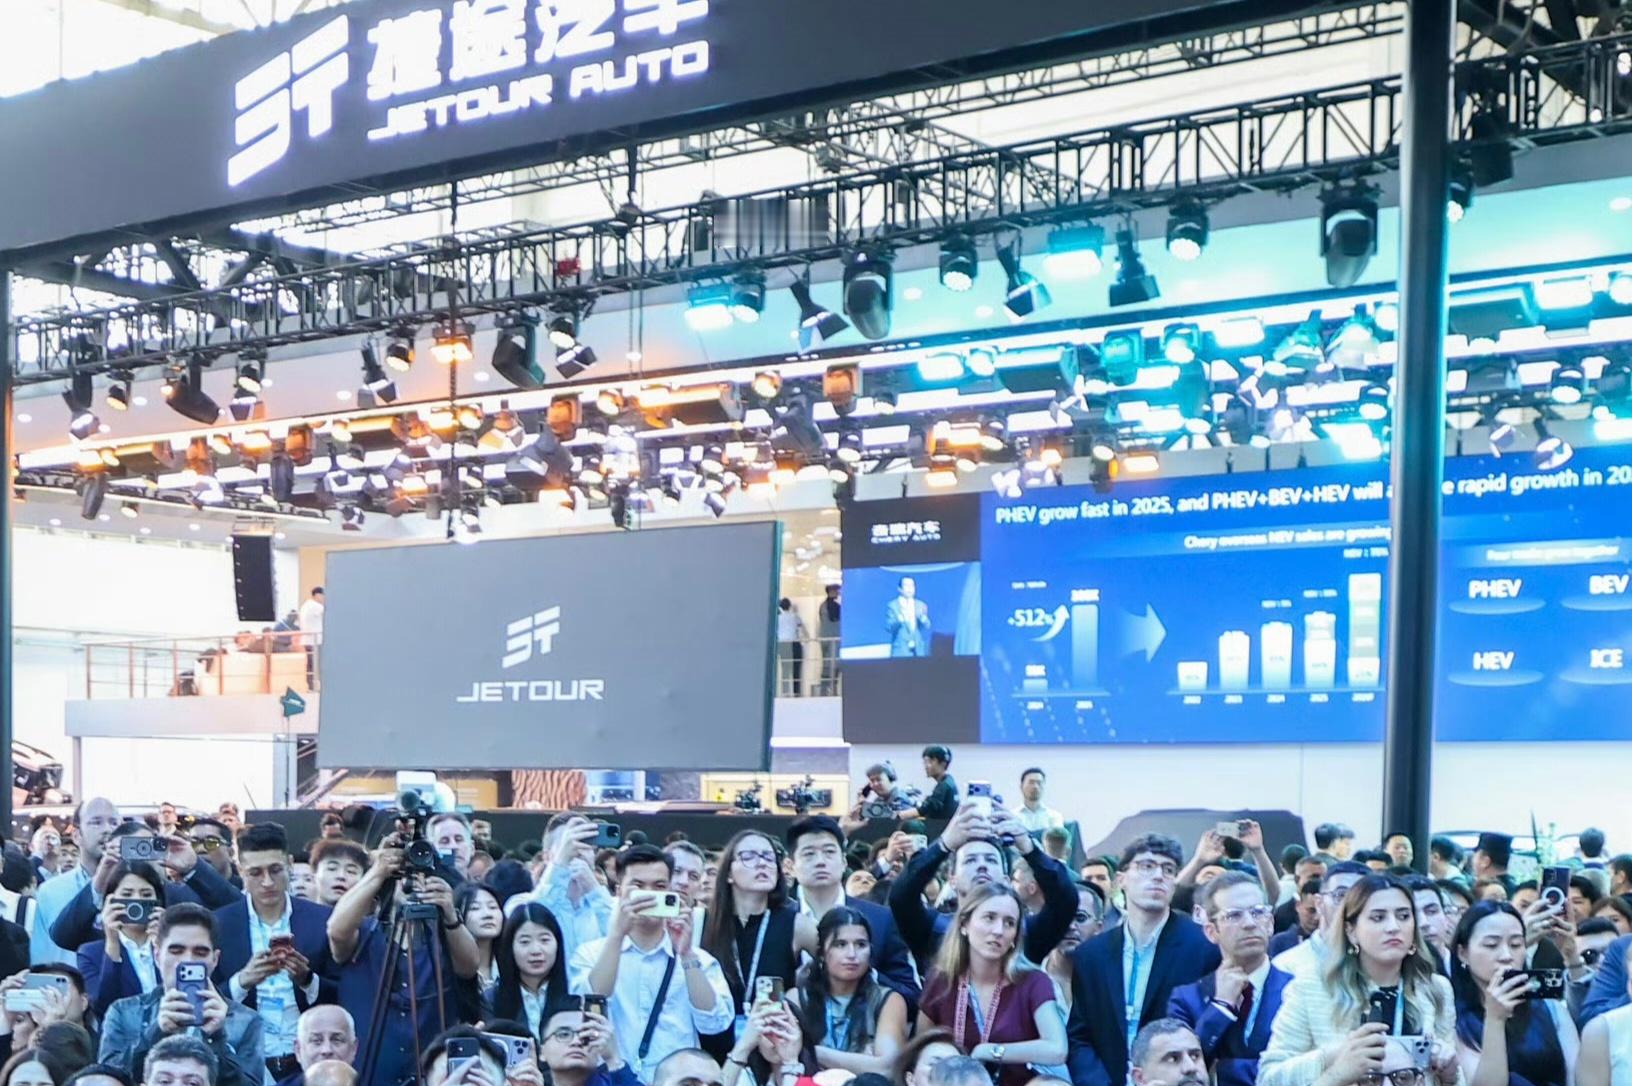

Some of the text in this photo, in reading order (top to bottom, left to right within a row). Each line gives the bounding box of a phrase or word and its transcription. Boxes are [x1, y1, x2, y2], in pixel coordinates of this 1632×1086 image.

[367, 41, 709, 140] JETOUR AUTO
[1458, 472, 1507, 497] rapid
[1510, 468, 1579, 495] growth
[1583, 467, 1603, 486] in
[1606, 465, 1632, 485] 20
[995, 505, 1037, 524] PHEV
[1039, 506, 1078, 525] grow
[1081, 500, 1110, 517] fast
[1113, 499, 1128, 516] in
[1131, 496, 1174, 515] 2025,
[1177, 493, 1210, 512] and
[1212, 484, 1351, 509] PHEV+BEV+HEV
[1353, 481, 1384, 500] will
[1468, 574, 1630, 599] PHEV BEV
[1472, 648, 1624, 671] HEV ICE
[456, 679, 605, 703] JETOUR
